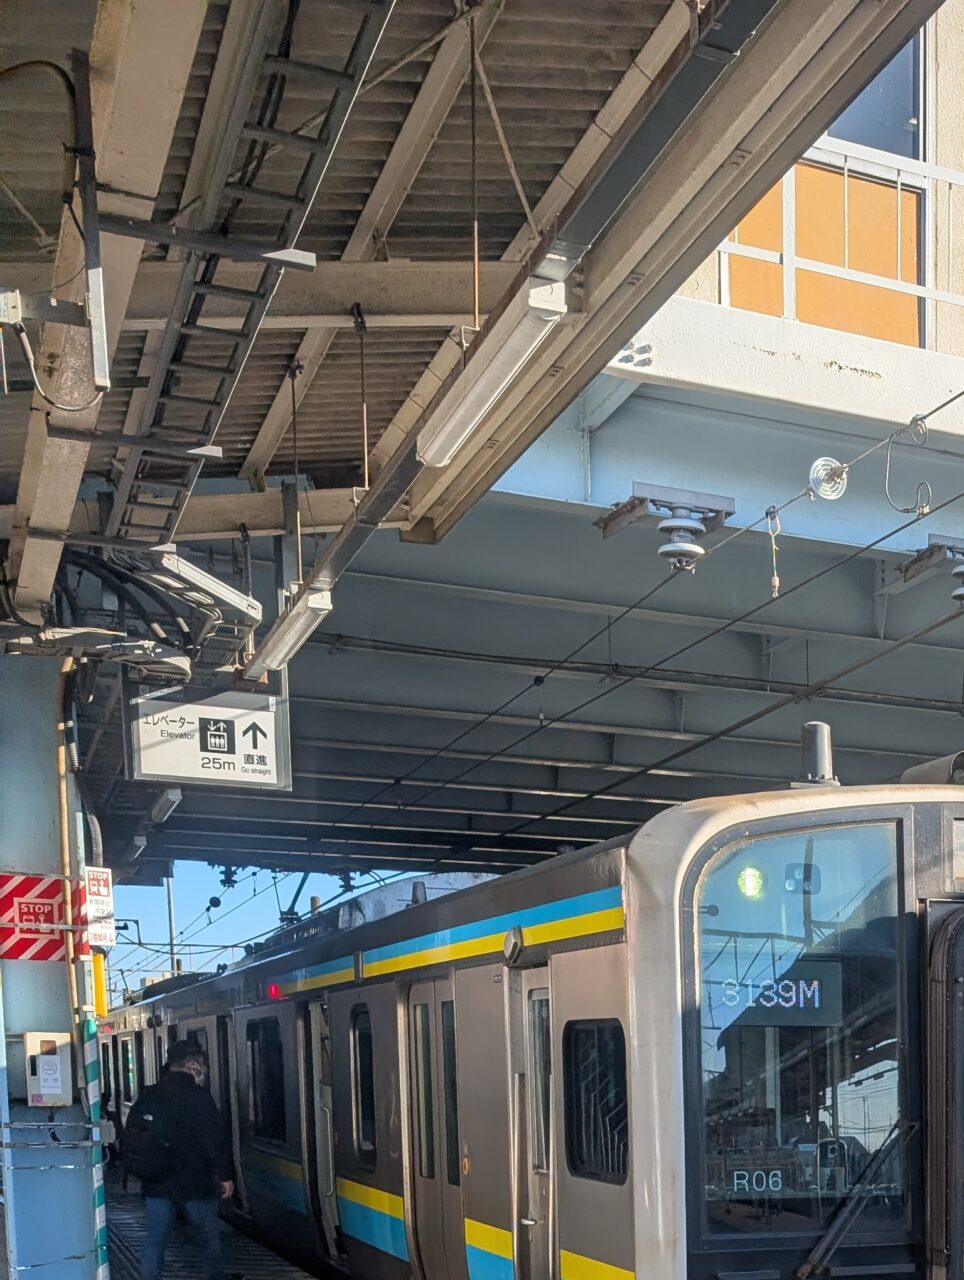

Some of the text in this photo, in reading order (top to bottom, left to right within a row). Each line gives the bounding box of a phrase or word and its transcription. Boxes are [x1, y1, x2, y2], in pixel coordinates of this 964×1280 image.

[143, 713, 196, 728] エレベーター
[160, 729, 196, 740] Elevator
[201, 756, 236, 771] 25m
[243, 753, 268, 766] 直進
[241, 766, 272, 776] Go straight
[88, 871, 109, 880] STOP
[20, 903, 52, 914] STOP
[721, 979, 819, 1008] 3139M
[733, 1170, 782, 1191] R06
